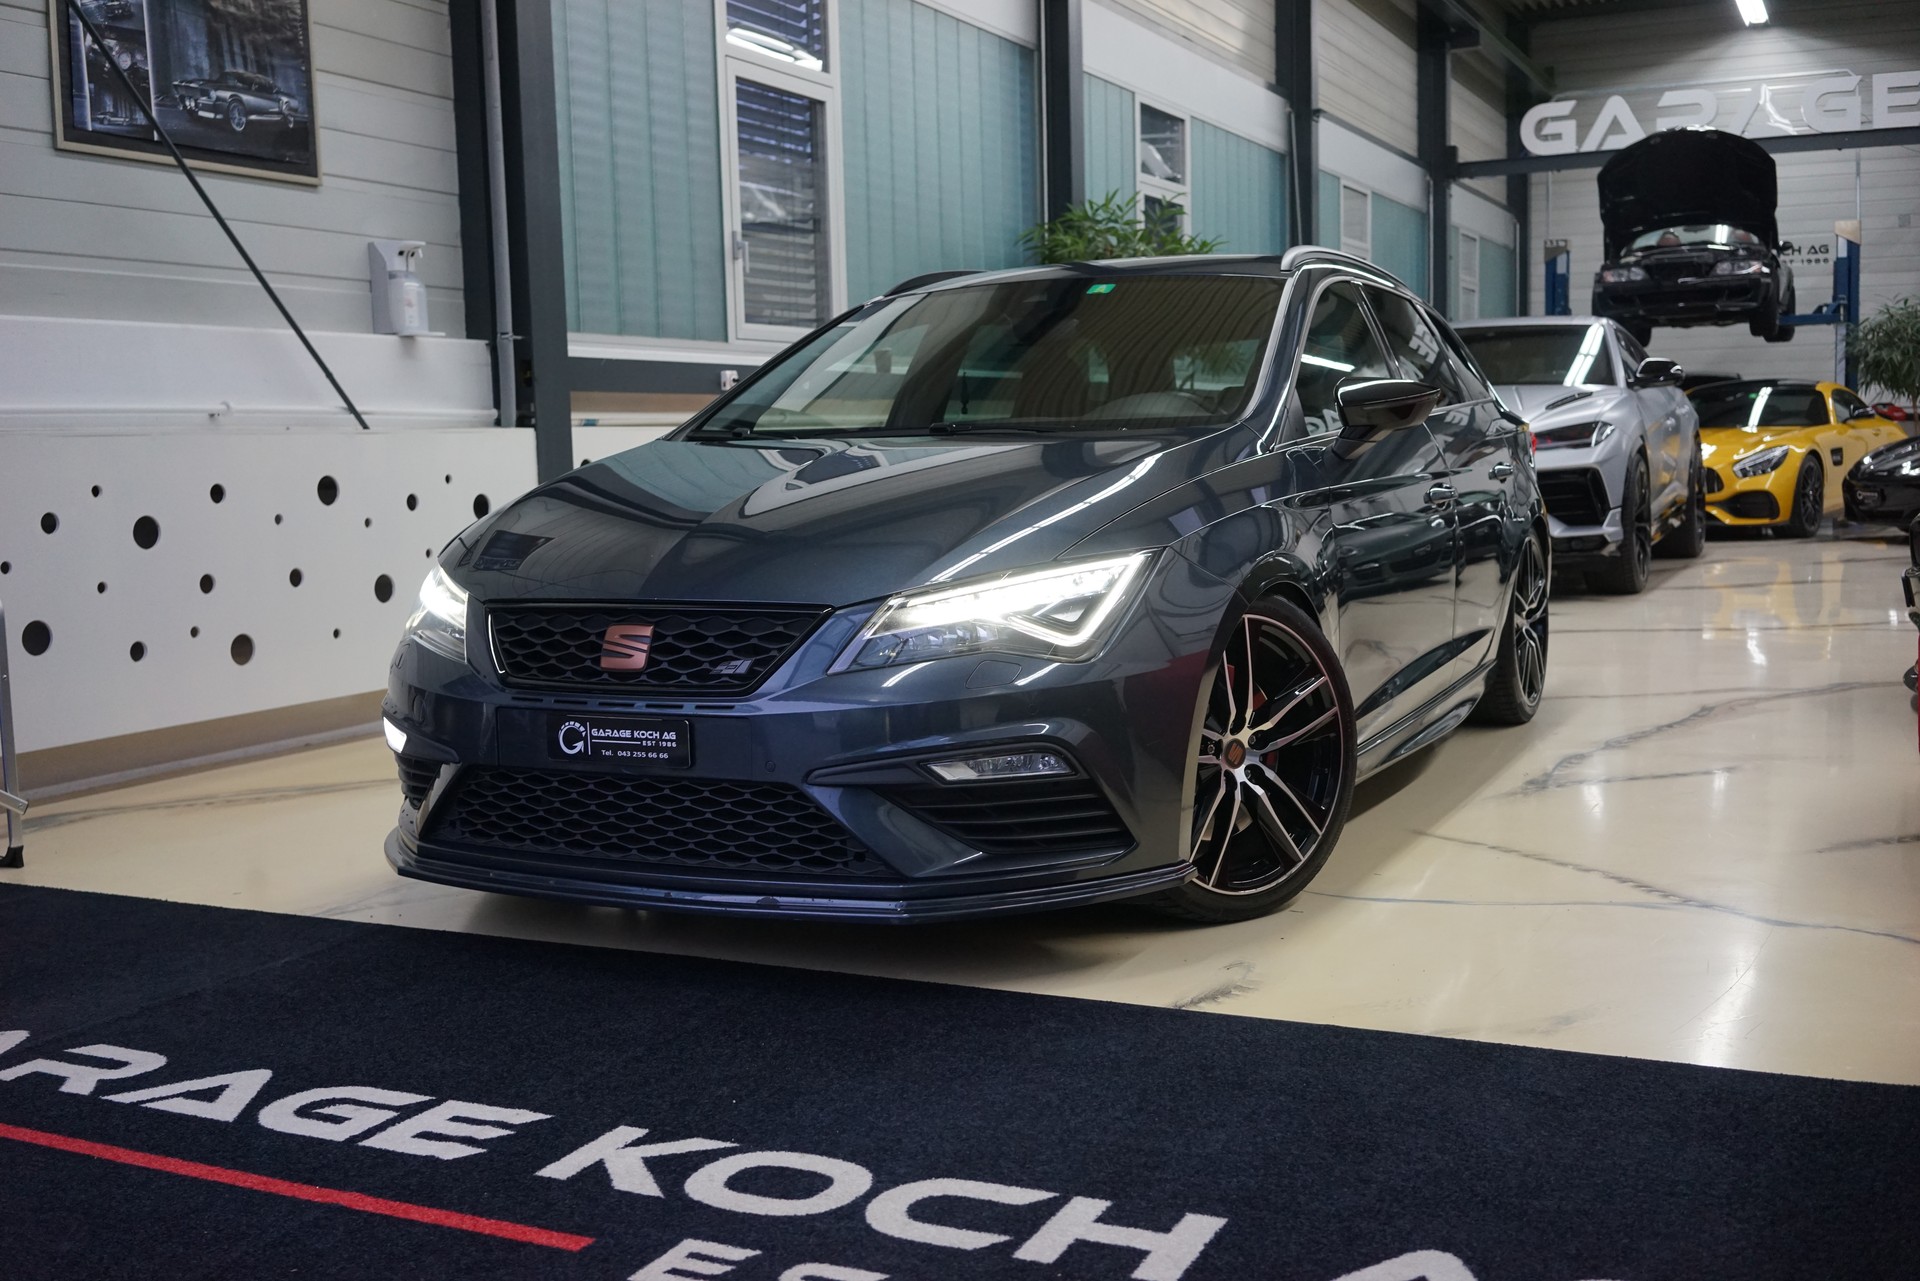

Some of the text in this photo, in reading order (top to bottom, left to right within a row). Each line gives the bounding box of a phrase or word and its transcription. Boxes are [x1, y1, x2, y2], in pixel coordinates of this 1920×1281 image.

[1807, 244, 1829, 255] AG
[591, 728, 677, 740] GARAGE KOCH AG
[0, 1031, 1228, 1281] RAGE KOCH
